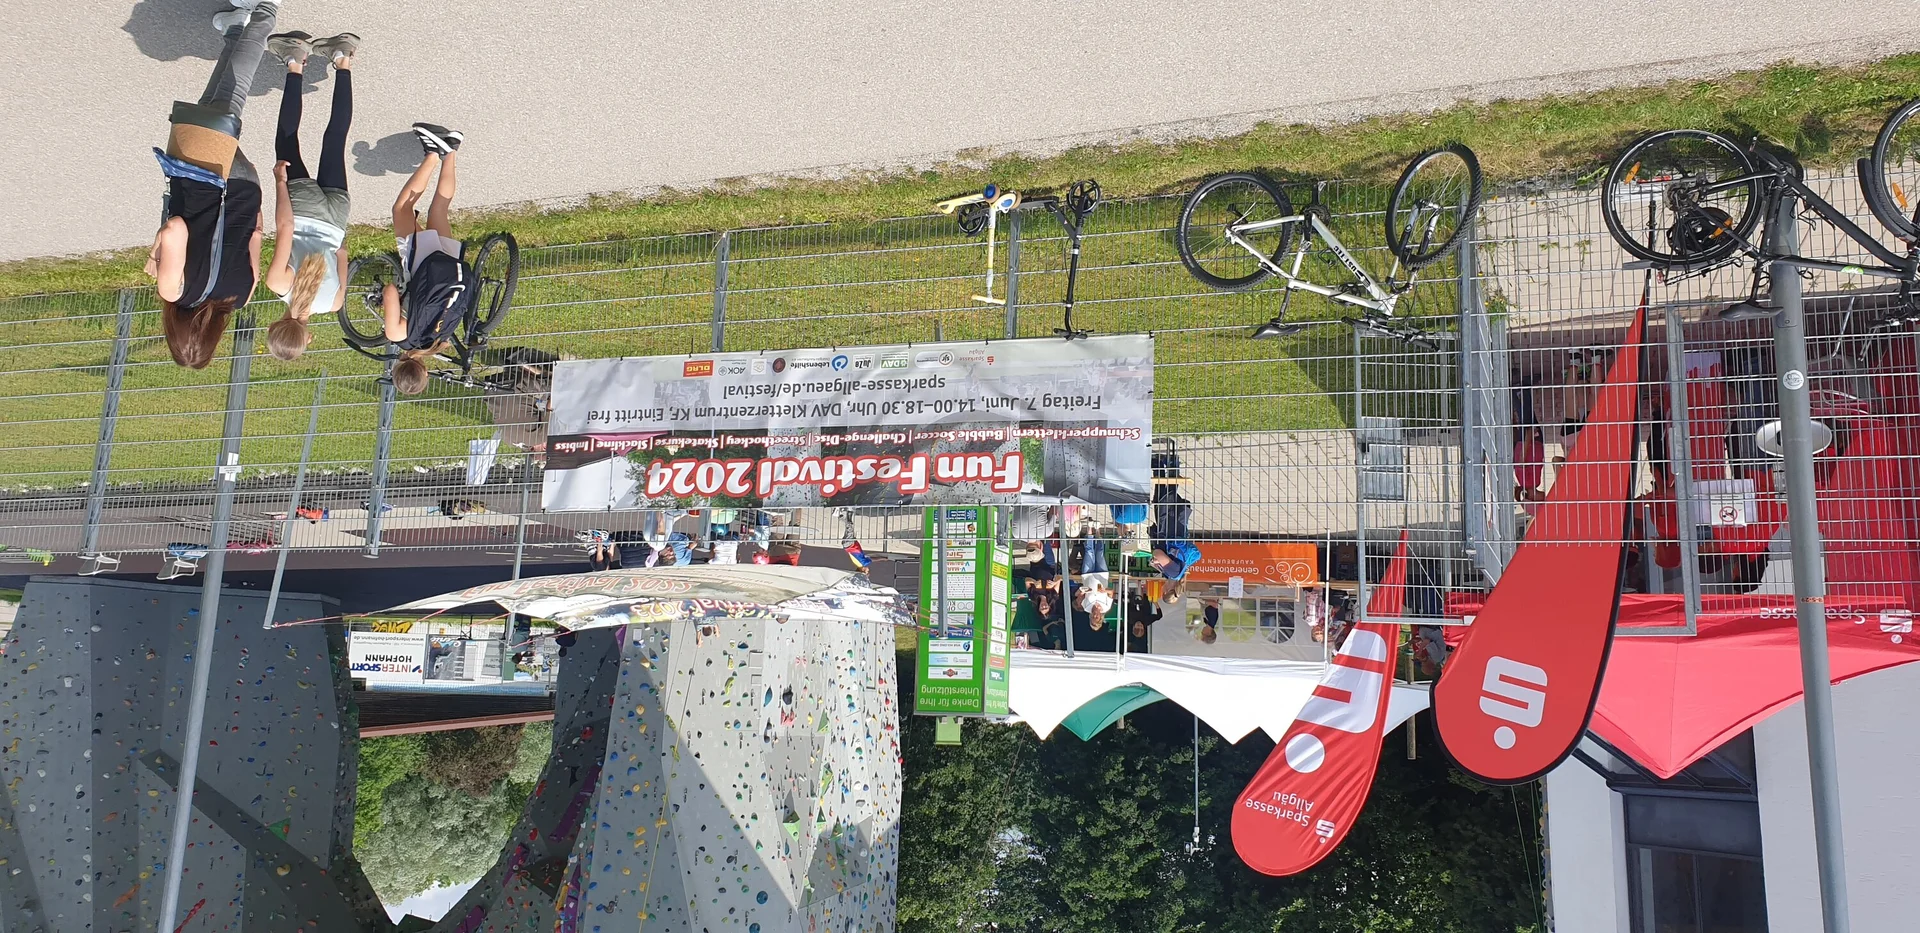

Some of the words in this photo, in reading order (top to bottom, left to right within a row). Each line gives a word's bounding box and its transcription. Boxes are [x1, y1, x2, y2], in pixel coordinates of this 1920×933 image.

[790, 361, 830, 370] Lebenshilfe
[881, 359, 900, 368] DAV
[958, 355, 985, 363] Sparkasse
[686, 364, 710, 372] DLRG
[727, 366, 746, 375] AOK
[722, 374, 946, 400] sparkasse-allgaeu.de/festival
[810, 402, 842, 418] DAV
[847, 399, 877, 417] Uhr,
[980, 394, 1019, 413] Juni,
[1024, 396, 1037, 412] 7.
[1042, 392, 1102, 412] Freitag
[585, 410, 611, 426] frei
[614, 407, 664, 425] Eintritt
[668, 405, 691, 422] KF,
[693, 402, 807, 422] Kletterzentrum
[725, 433, 807, 450] Streethockey
[814, 430, 907, 448] Challenge-Disc
[914, 429, 957, 445] Soccer
[957, 428, 1003, 443] Bubble
[1011, 426, 1141, 443] Schnupperklettern
[553, 439, 589, 456] Imbiss
[593, 437, 649, 454] Slackline
[654, 435, 720, 452] Skatekurse
[645, 457, 753, 497] 2024
[756, 453, 930, 497] Festival
[932, 451, 1023, 494] Fun
[1185, 565, 1259, 575] Generationenhaus
[1759, 605, 1866, 624] Spasse
[364, 654, 412, 663] HOFMANN
[349, 663, 411, 673] INTERSPORT
[921, 684, 980, 697] Unterstützung
[920, 697, 936, 707] Ihre
[938, 698, 950, 707] für
[952, 698, 979, 708] Danke
[1272, 791, 1315, 812] Allgäu
[1245, 798, 1311, 827] Sparkasse
